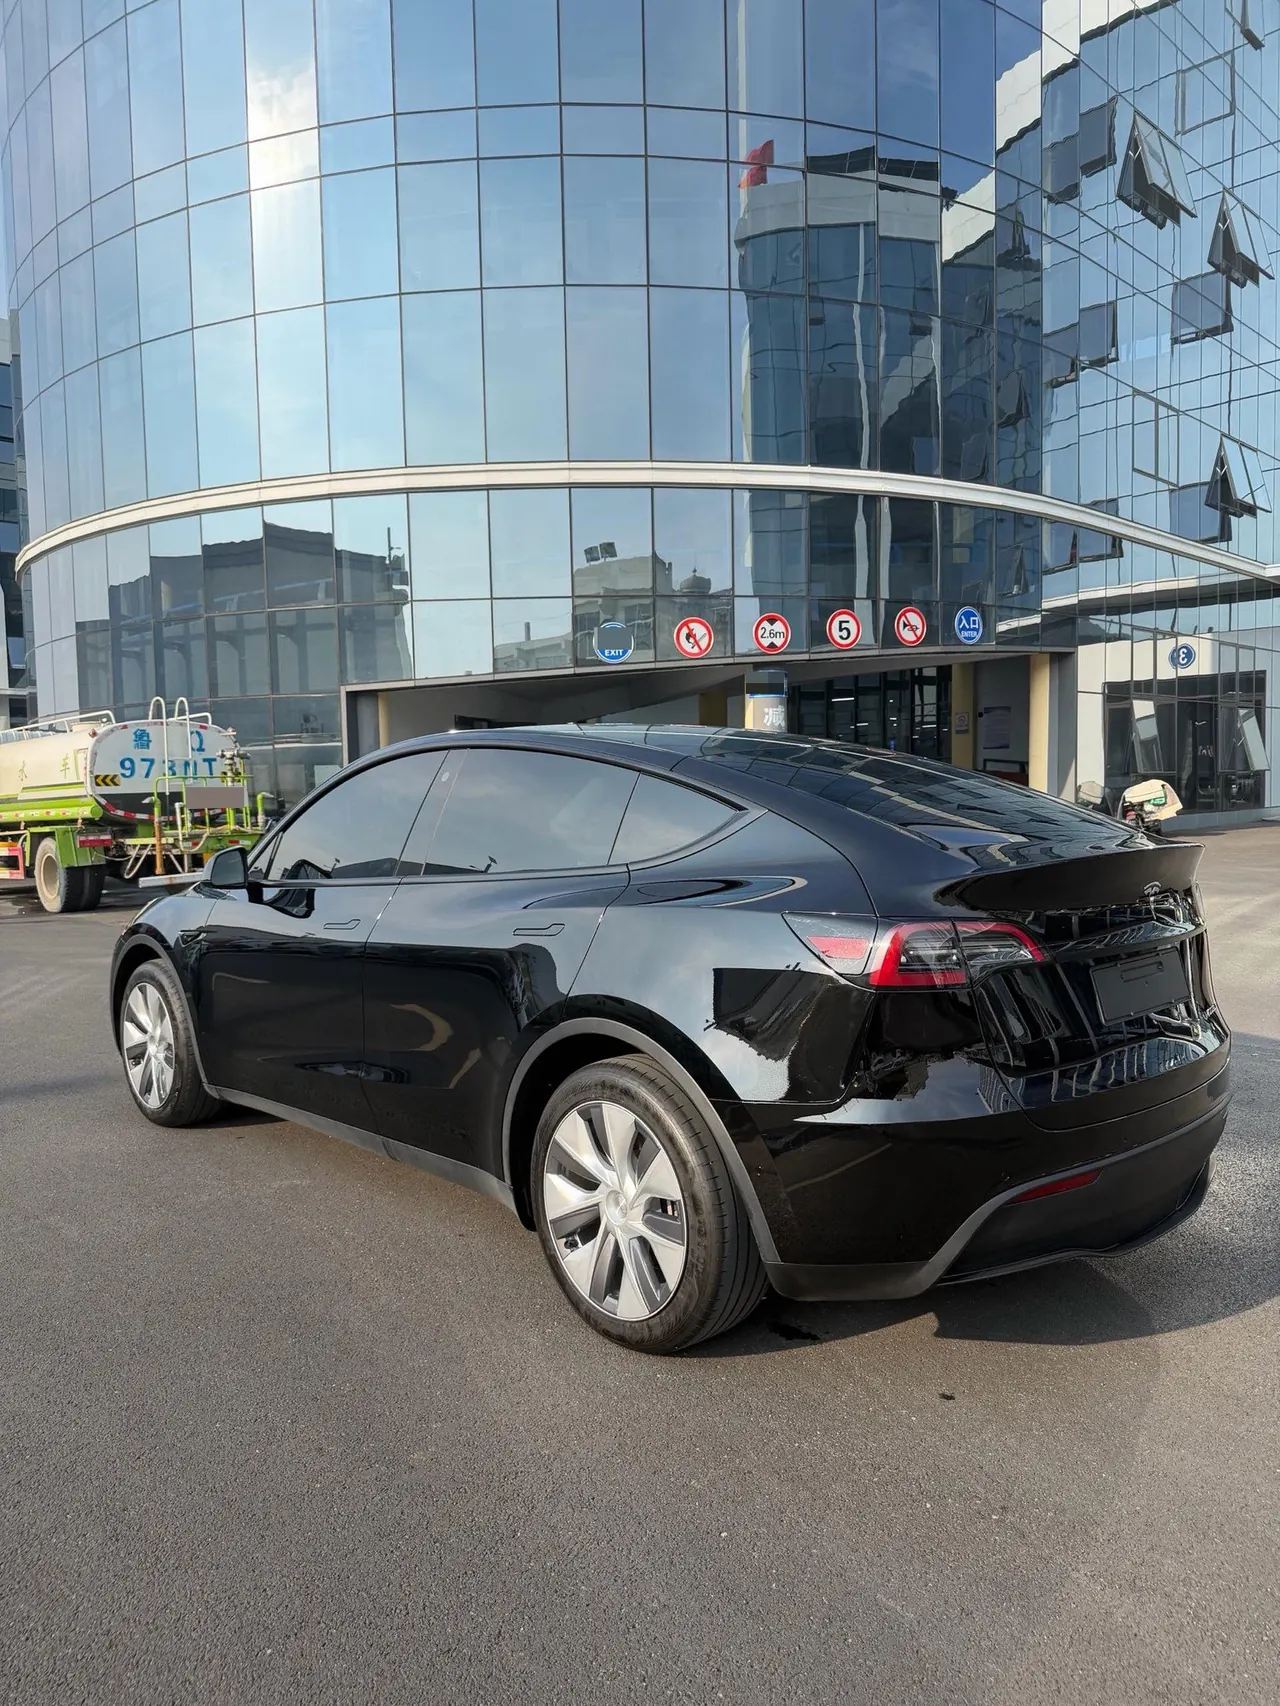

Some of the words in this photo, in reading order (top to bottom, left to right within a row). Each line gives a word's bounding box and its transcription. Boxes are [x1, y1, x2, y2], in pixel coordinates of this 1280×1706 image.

[959, 615, 979, 629] 入口
[760, 627, 785, 639] 2.6m
[838, 620, 851, 640] 5
[961, 630, 978, 639] ENTER
[604, 649, 623, 657] EXIT
[763, 705, 785, 728] 减
